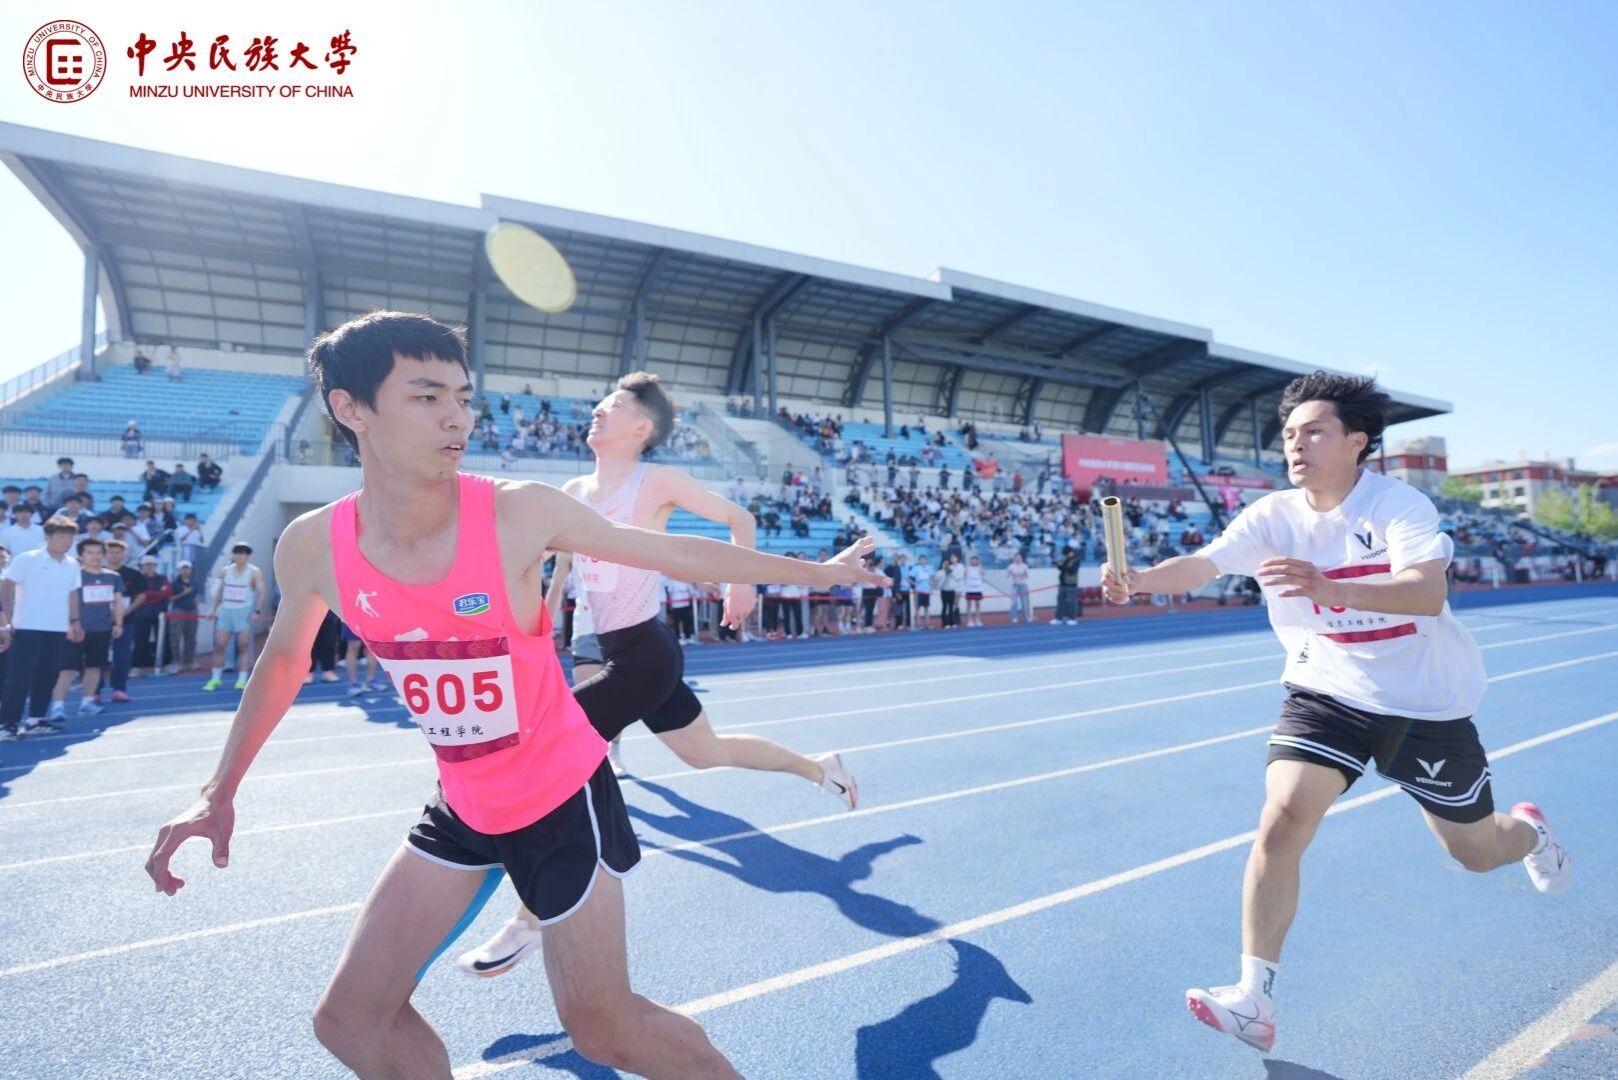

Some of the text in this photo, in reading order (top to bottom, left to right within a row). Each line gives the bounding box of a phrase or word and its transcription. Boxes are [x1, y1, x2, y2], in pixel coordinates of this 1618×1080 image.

[386, 670, 504, 715] 605
[419, 723, 484, 738] 工程学院
[1415, 776, 1453, 788] VEIDONT
